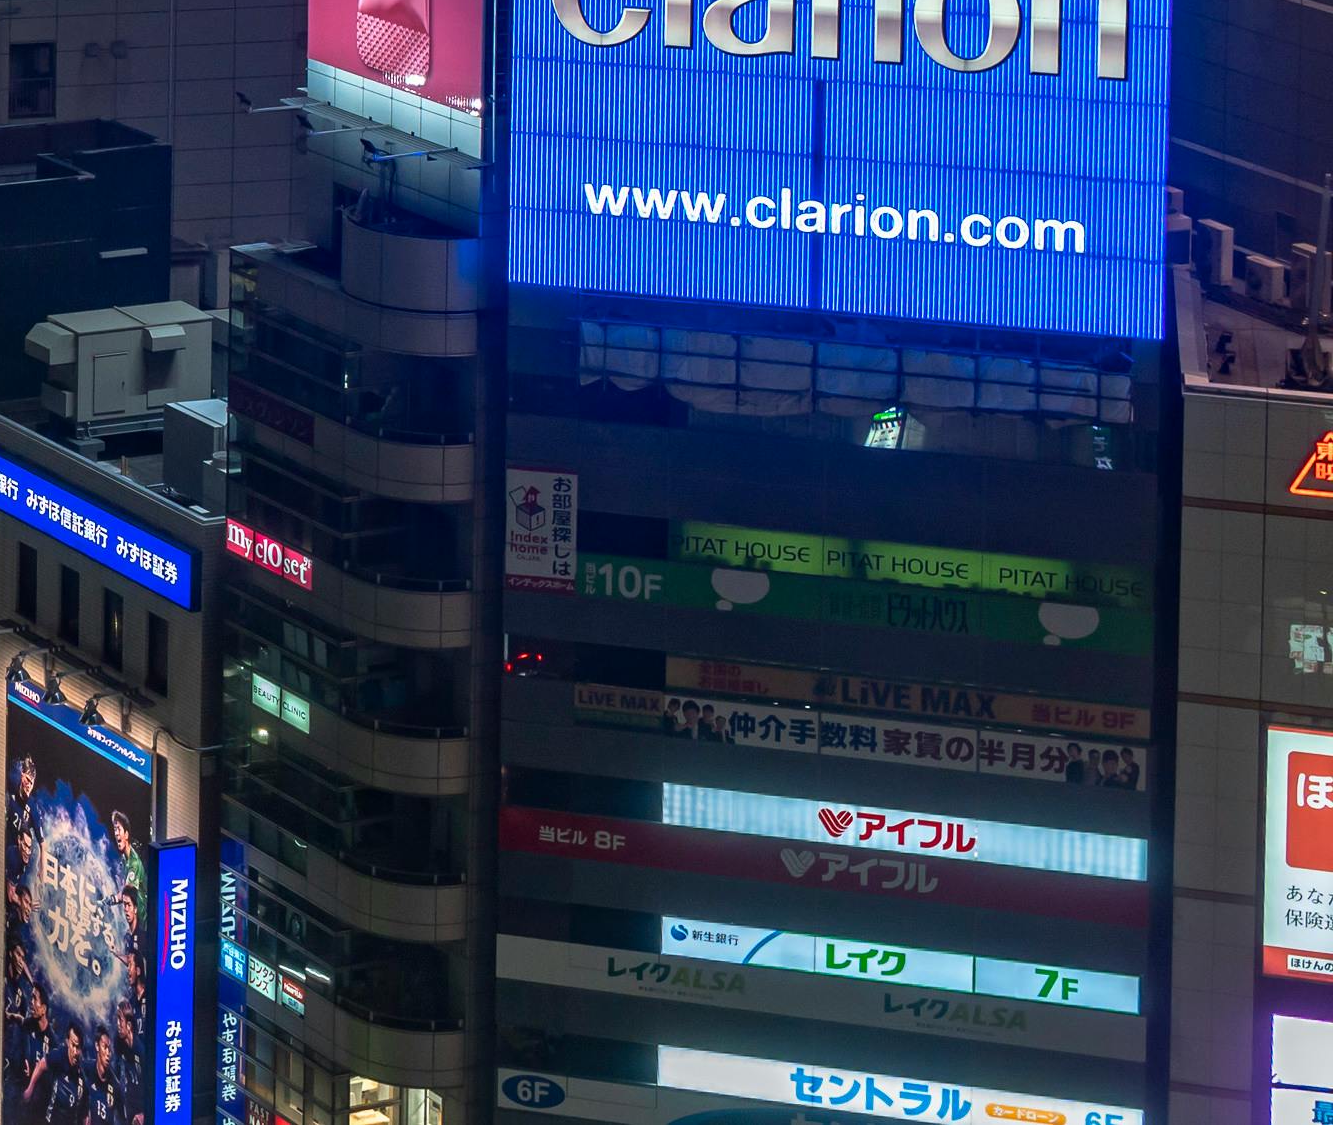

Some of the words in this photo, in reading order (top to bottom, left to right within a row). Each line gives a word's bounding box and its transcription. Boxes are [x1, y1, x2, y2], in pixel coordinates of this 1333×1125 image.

[582, 181, 1088, 256] www.clarion.com
[26, 488, 109, 549] みずほ信託銀行
[115, 535, 180, 586] みずほ証券
[227, 523, 253, 557] my
[551, 476, 572, 577] お部屋探しは
[509, 544, 549, 555] home
[672, 535, 729, 555] PITAT
[734, 540, 811, 564] HOUSE
[826, 549, 886, 571] PITAT
[891, 555, 970, 581] HOUSE
[597, 562, 663, 600] 10F
[999, 566, 1059, 588] PITAT
[1064, 574, 1144, 598] HOUSE
[14, 680, 41, 704] MIZUHO
[253, 684, 281, 706] BEAUTY
[282, 700, 307, 721] CLINIC
[577, 690, 617, 708] LiVE
[620, 695, 661, 713] MAX
[840, 677, 911, 709] LiVE
[920, 688, 997, 721] MAX
[727, 709, 878, 753] 仲介手数料
[1032, 704, 1096, 725] 当ビル
[1101, 710, 1137, 731] 9F
[538, 825, 588, 846] 当ビル
[593, 831, 626, 852] 8F
[856, 811, 976, 853] アイフル
[819, 851, 939, 894] アイフル
[169, 879, 188, 970] MIZUHO
[691, 929, 740, 947] 新生銀行
[248, 973, 270, 994] レンズ
[606, 956, 746, 995] レイクALSA
[825, 943, 907, 976] レイク
[1035, 967, 1079, 1001] 7F
[883, 992, 1028, 1032] レイクALSA
[164, 1020, 183, 1113] みずほ証券
[516, 1079, 551, 1103] 6F
[789, 1066, 973, 1122] セントラル
[992, 1106, 1059, 1123] カードローン
